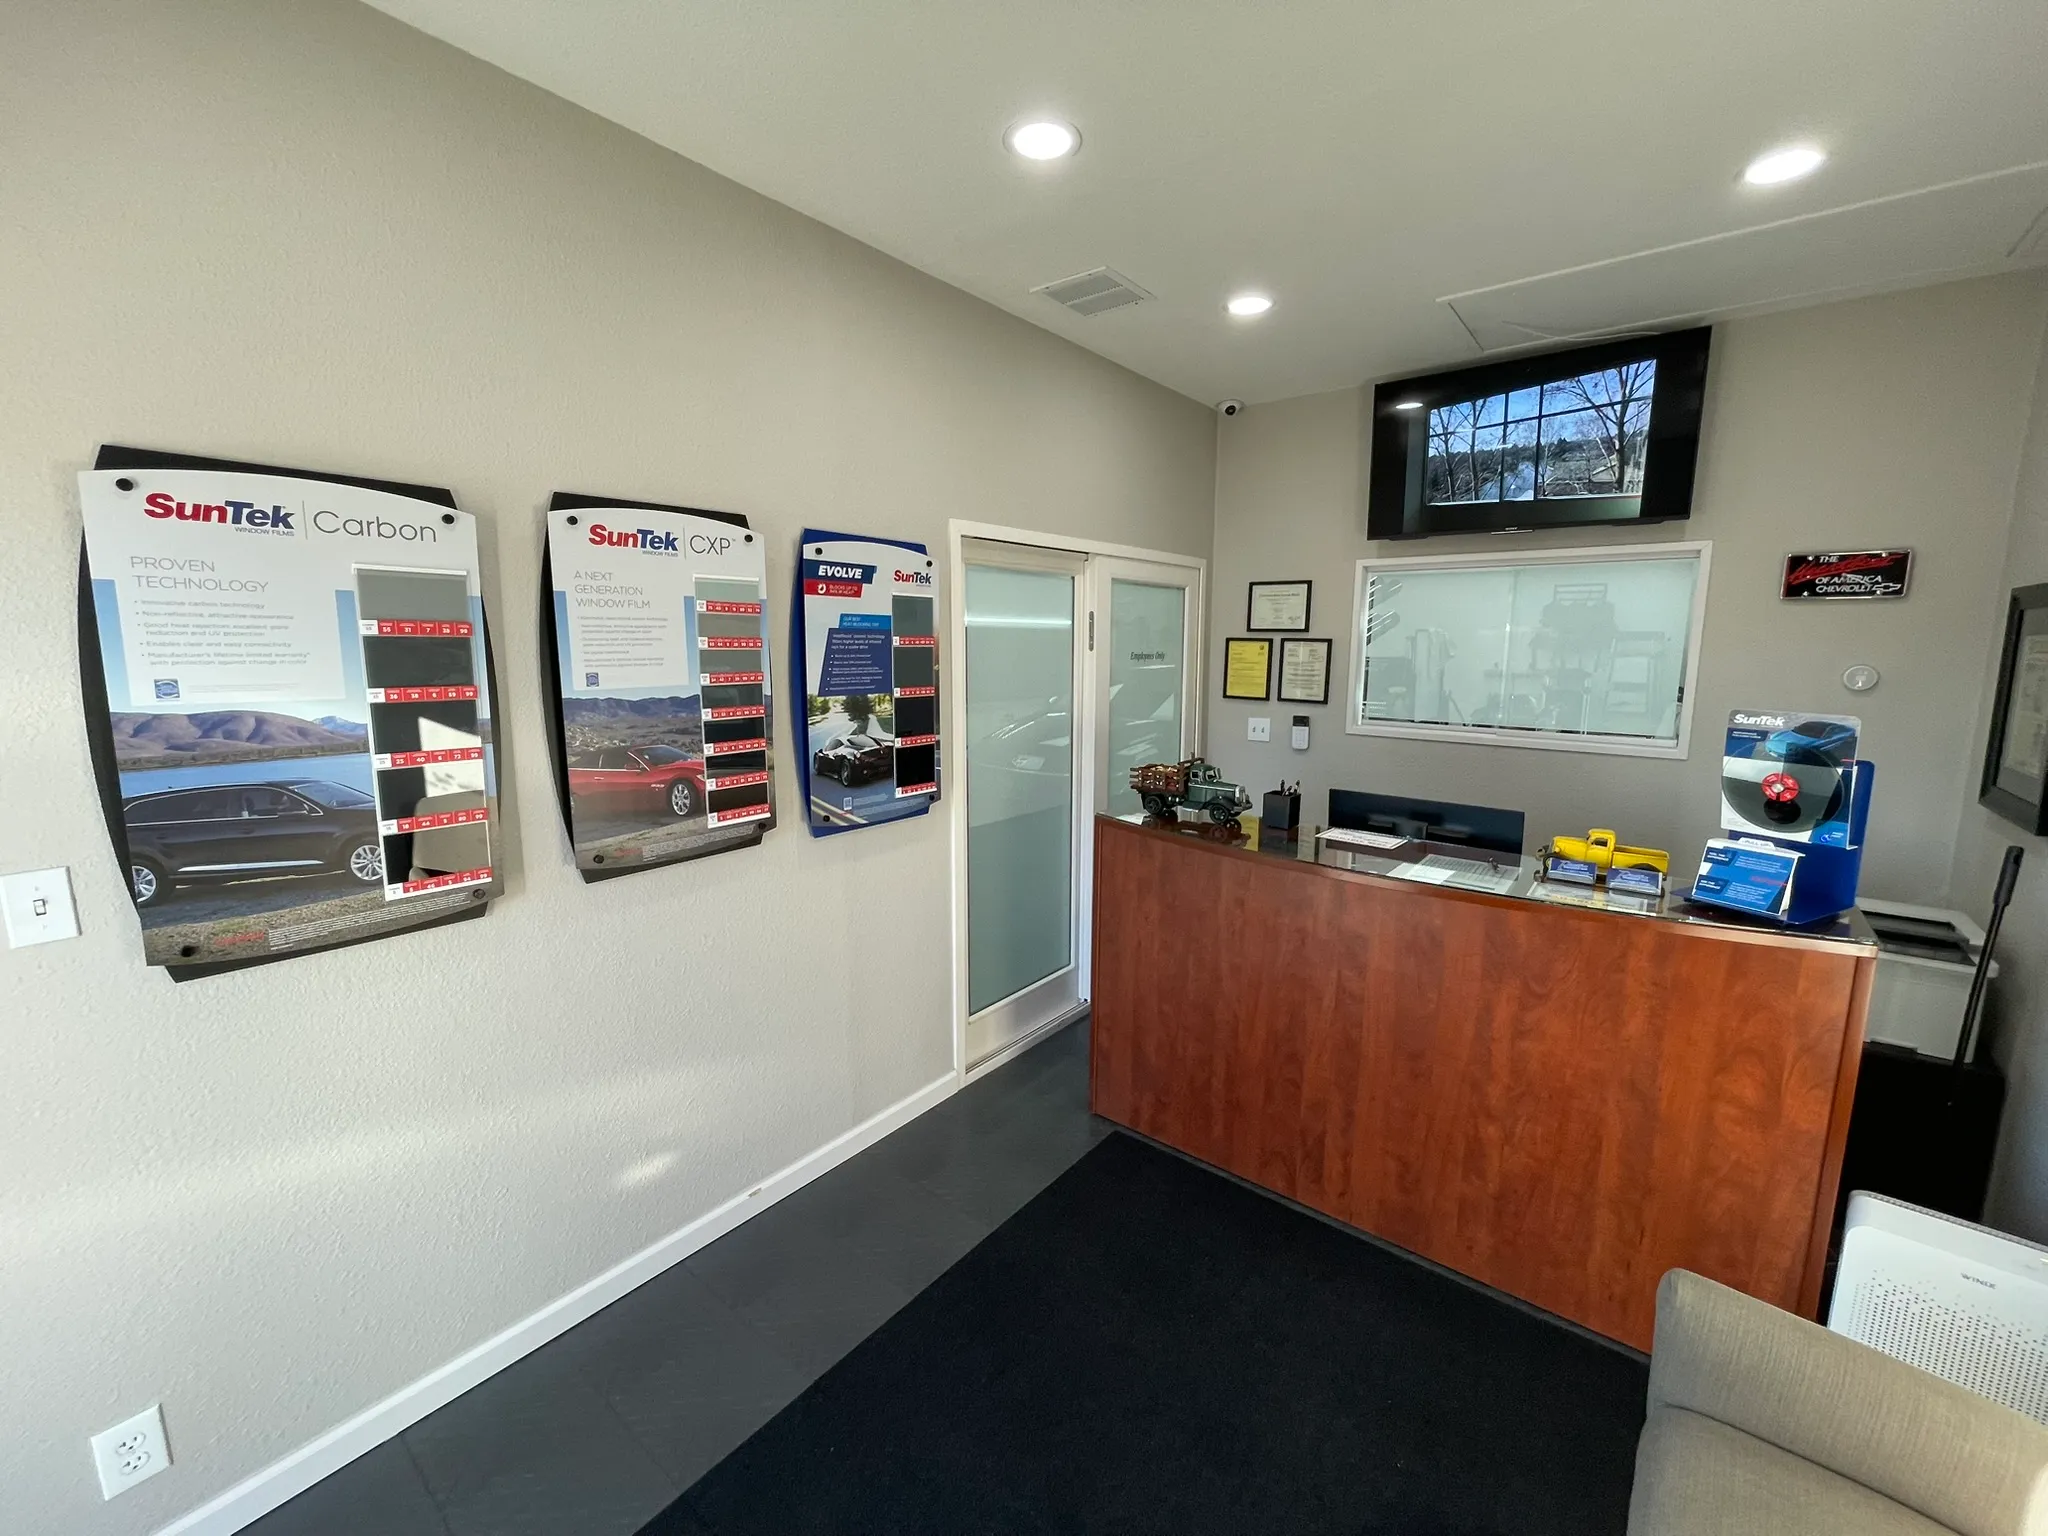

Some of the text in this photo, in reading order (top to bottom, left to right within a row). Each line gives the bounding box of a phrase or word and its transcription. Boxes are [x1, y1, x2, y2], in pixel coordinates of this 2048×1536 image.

[144, 492, 436, 542] SunTek Carbon
[234, 526, 295, 537] WINDOW FILMS
[588, 524, 679, 551] SunTek
[130, 556, 215, 573] PROVEN
[1819, 555, 1839, 563] THE
[573, 570, 613, 582] A NEXT
[818, 565, 932, 584] EVOLVE SunTek
[1815, 575, 1882, 584] OF AMERICA
[132, 575, 268, 593] TECHNOLOGY
[574, 584, 643, 596] GENERATION
[1815, 584, 1871, 593] CHEVROLET
[576, 597, 651, 609] WINDOW FILM
[1130, 652, 1165, 662] Employees Only
[1733, 713, 1785, 726] SunTek
